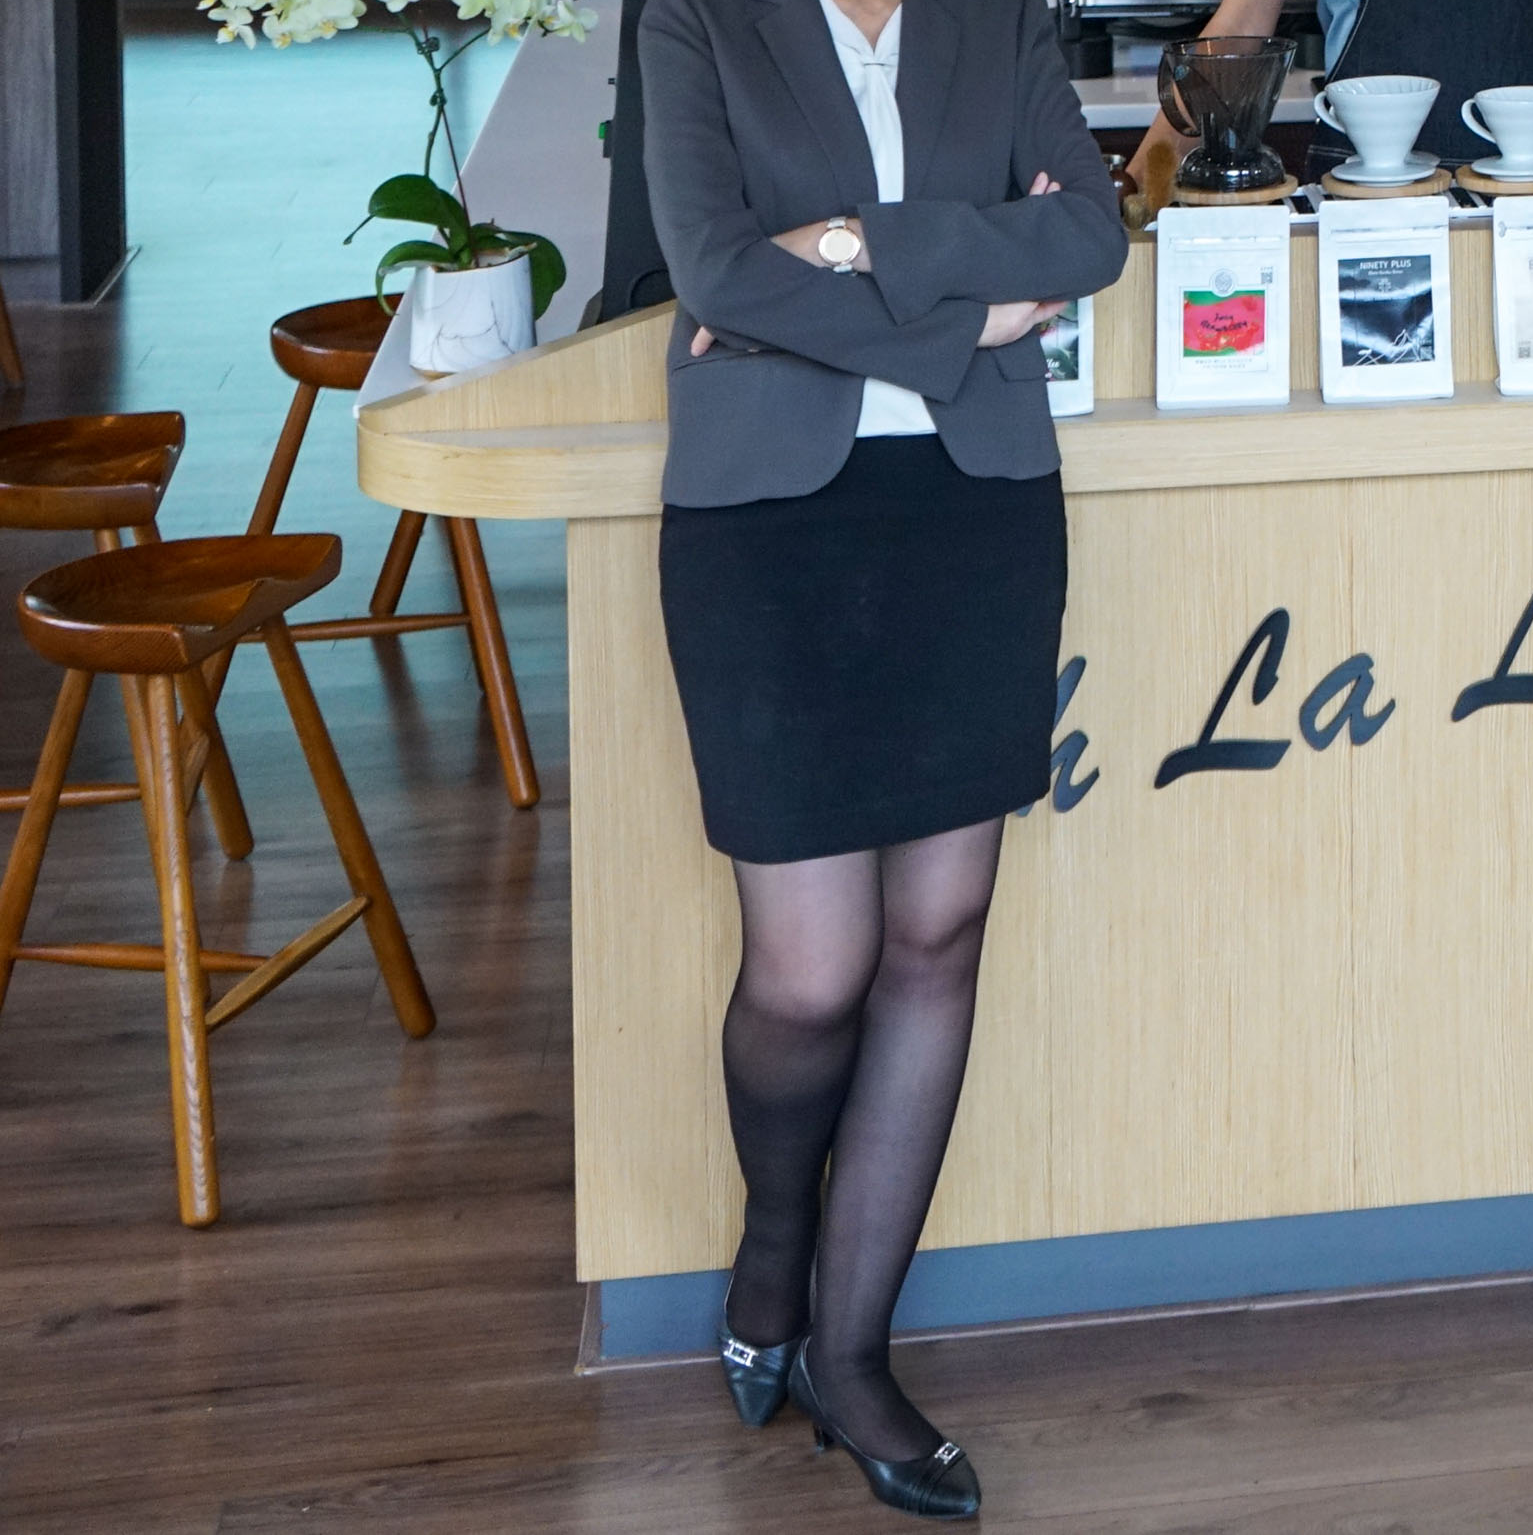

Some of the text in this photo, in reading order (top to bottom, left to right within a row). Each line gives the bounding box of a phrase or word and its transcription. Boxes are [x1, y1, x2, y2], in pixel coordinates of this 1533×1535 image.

[1360, 259, 1412, 270] NINETY PLUS
[1154, 607, 1396, 789] La
